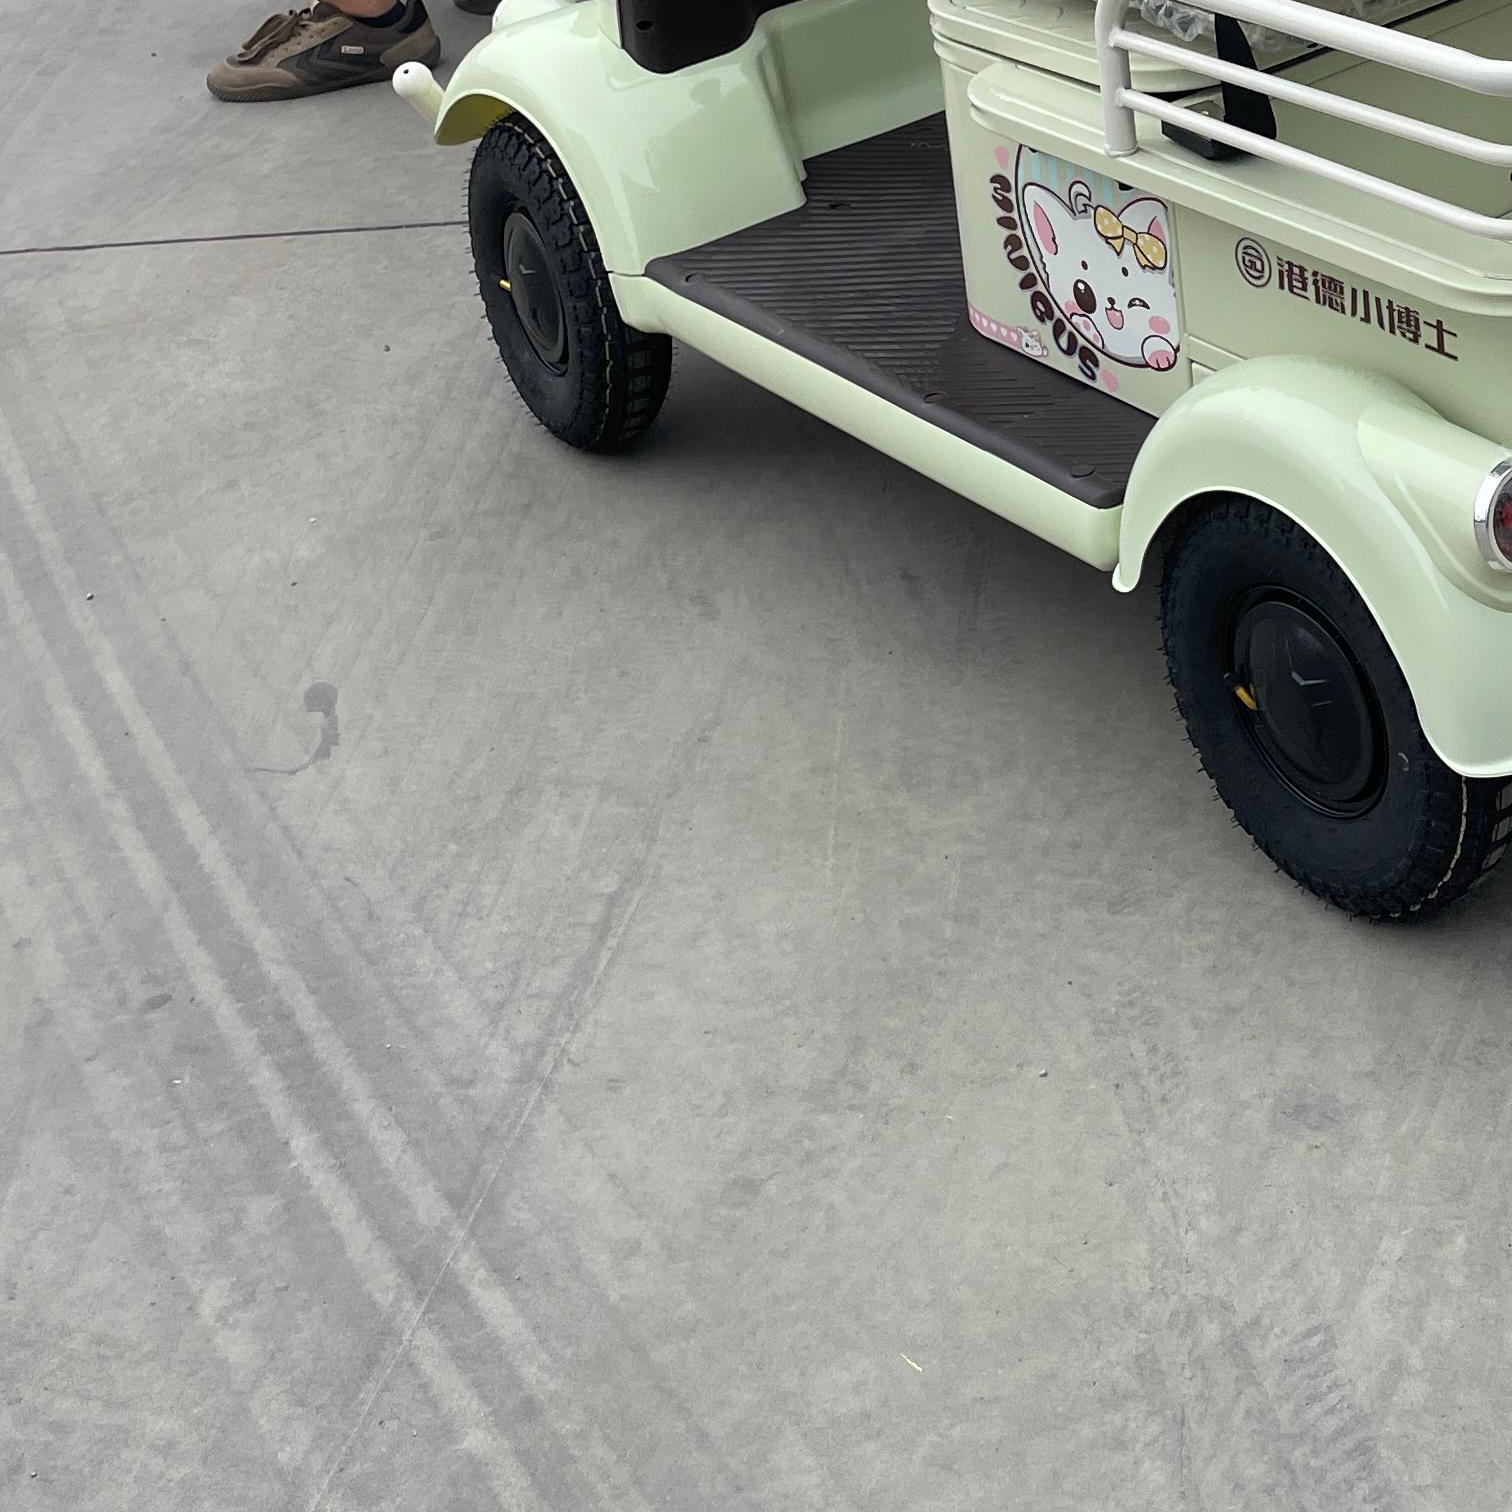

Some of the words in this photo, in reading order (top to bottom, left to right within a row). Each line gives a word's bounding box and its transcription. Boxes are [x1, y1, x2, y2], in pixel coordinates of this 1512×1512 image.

[1277, 255, 1458, 362] 港德小博士
